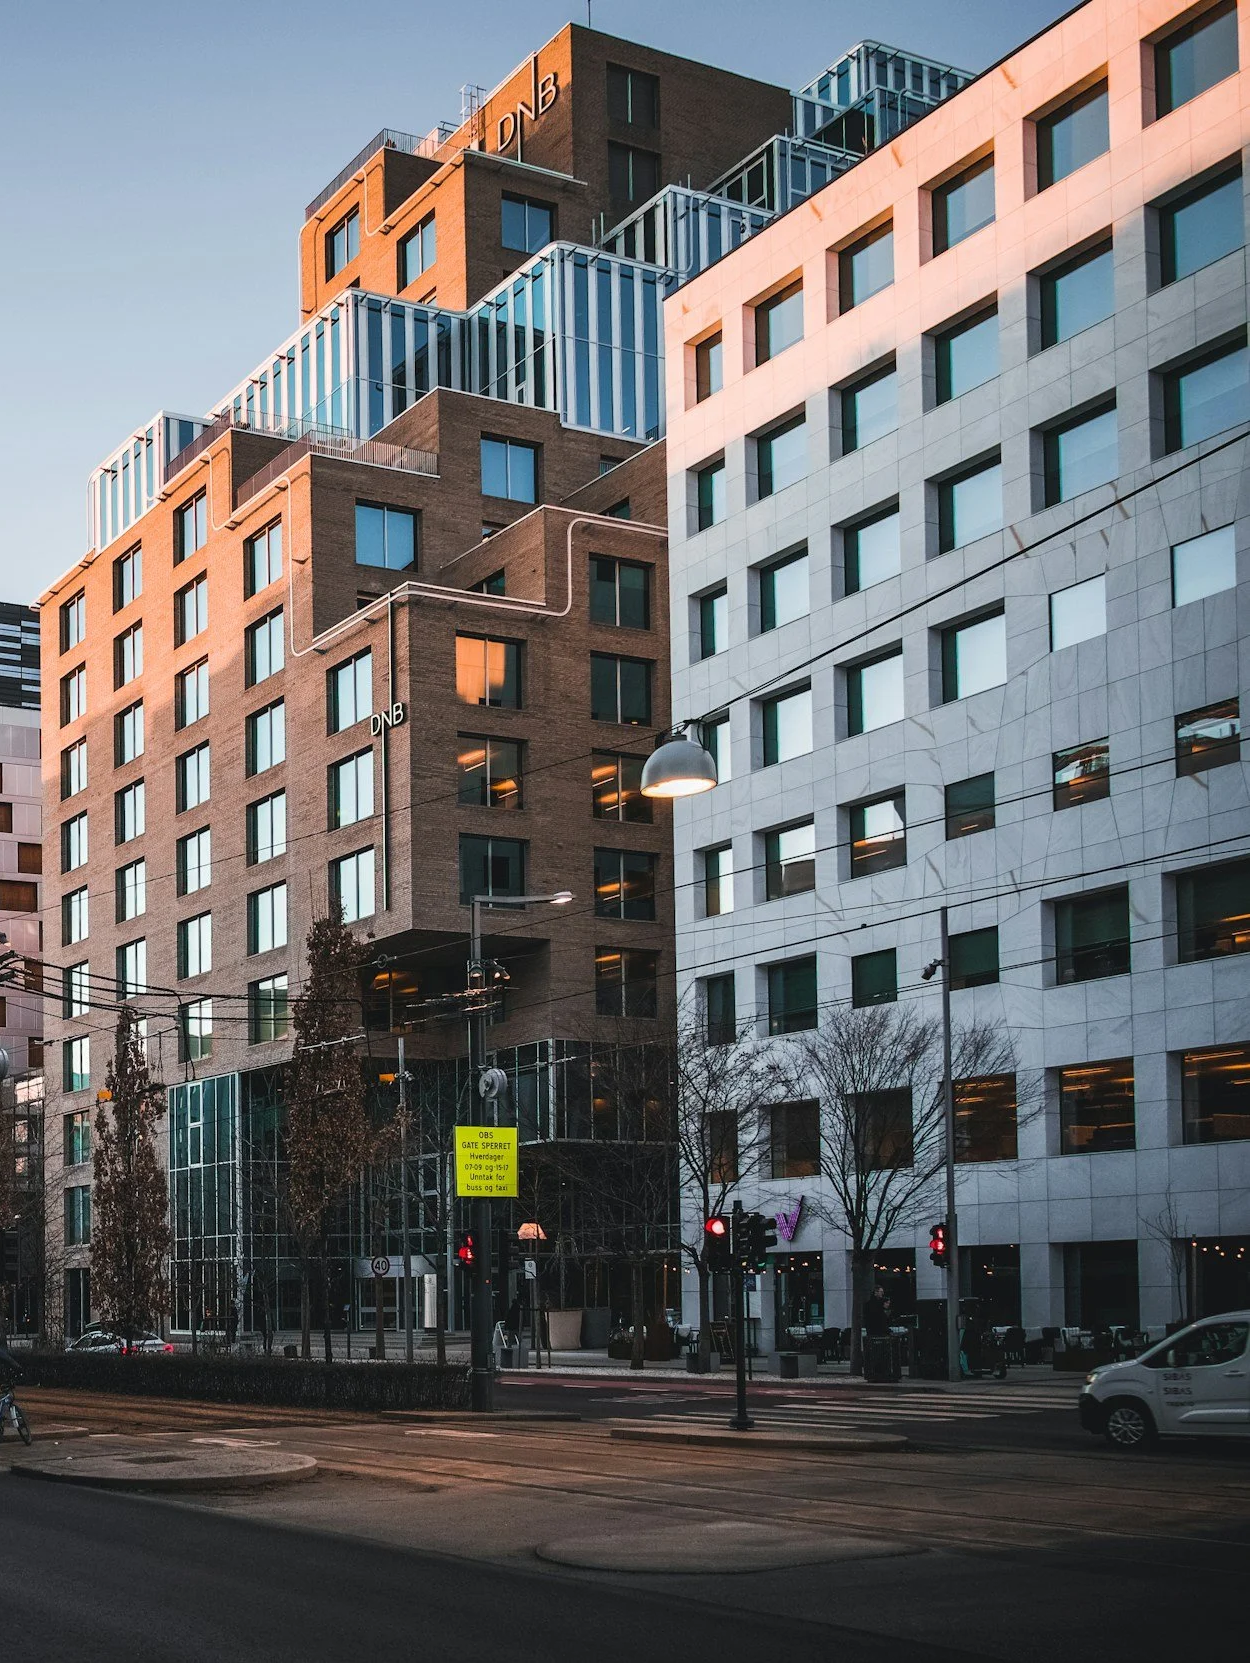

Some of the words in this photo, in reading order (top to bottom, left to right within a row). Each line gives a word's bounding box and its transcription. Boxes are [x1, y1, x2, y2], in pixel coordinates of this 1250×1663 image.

[497, 66, 557, 158] DNB
[370, 701, 404, 738] DNB
[478, 1131, 494, 1139] OBS
[461, 1141, 479, 1150] GATE
[481, 1141, 512, 1150] SPERRET
[469, 1152, 505, 1162] Hverdager
[464, 1163, 483, 1171] 07-09
[469, 1173, 493, 1181] Unntak
[496, 1173, 506, 1181] for
[466, 1183, 483, 1191] buss
[484, 1185, 493, 1193] og
[496, 1183, 508, 1191] taxi
[375, 1260, 387, 1271] 40
